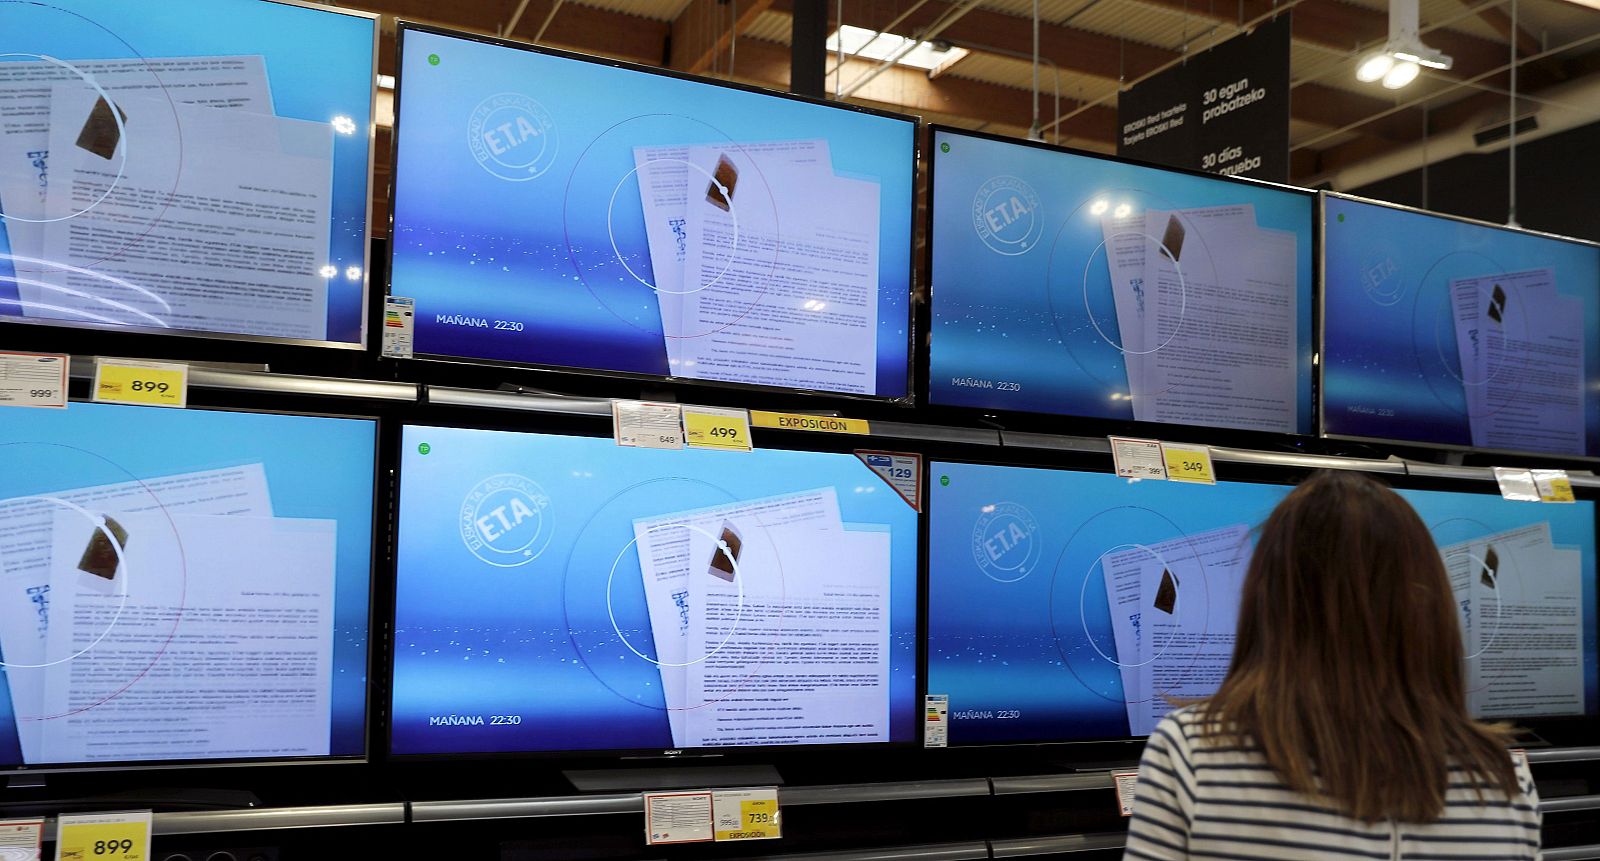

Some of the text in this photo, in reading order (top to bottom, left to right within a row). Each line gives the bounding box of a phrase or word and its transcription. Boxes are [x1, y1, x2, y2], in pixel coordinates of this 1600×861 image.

[1203, 78, 1249, 105] 30 egun
[1203, 87, 1266, 124] probatzeko
[1123, 118, 1147, 134] EROSKI
[1147, 112, 1160, 125] Red
[1123, 115, 1184, 145] Tarjeta EROSKI Red
[483, 116, 543, 156] E.T.A.
[1202, 146, 1243, 169] 30 días
[1219, 156, 1262, 175] prueba
[985, 195, 1032, 233] E.T.A.
[436, 314, 525, 332] MAÑANA 22:30
[131, 380, 170, 394] 899
[952, 377, 1021, 391] MAÑANA 22:30
[30, 389, 52, 398] 999
[779, 416, 848, 431] EXPOSICIÓN
[660, 435, 675, 444] 649
[710, 427, 738, 439] 499
[888, 467, 912, 479] 129
[1183, 461, 1203, 472] 349
[476, 497, 539, 543] E.T.A.
[984, 522, 1030, 562] E.T.A.
[429, 714, 522, 726] MAÑANA 22:30
[953, 709, 1020, 720] MAÑANA 22:30
[748, 813, 768, 824] 739
[93, 838, 133, 855] 899
